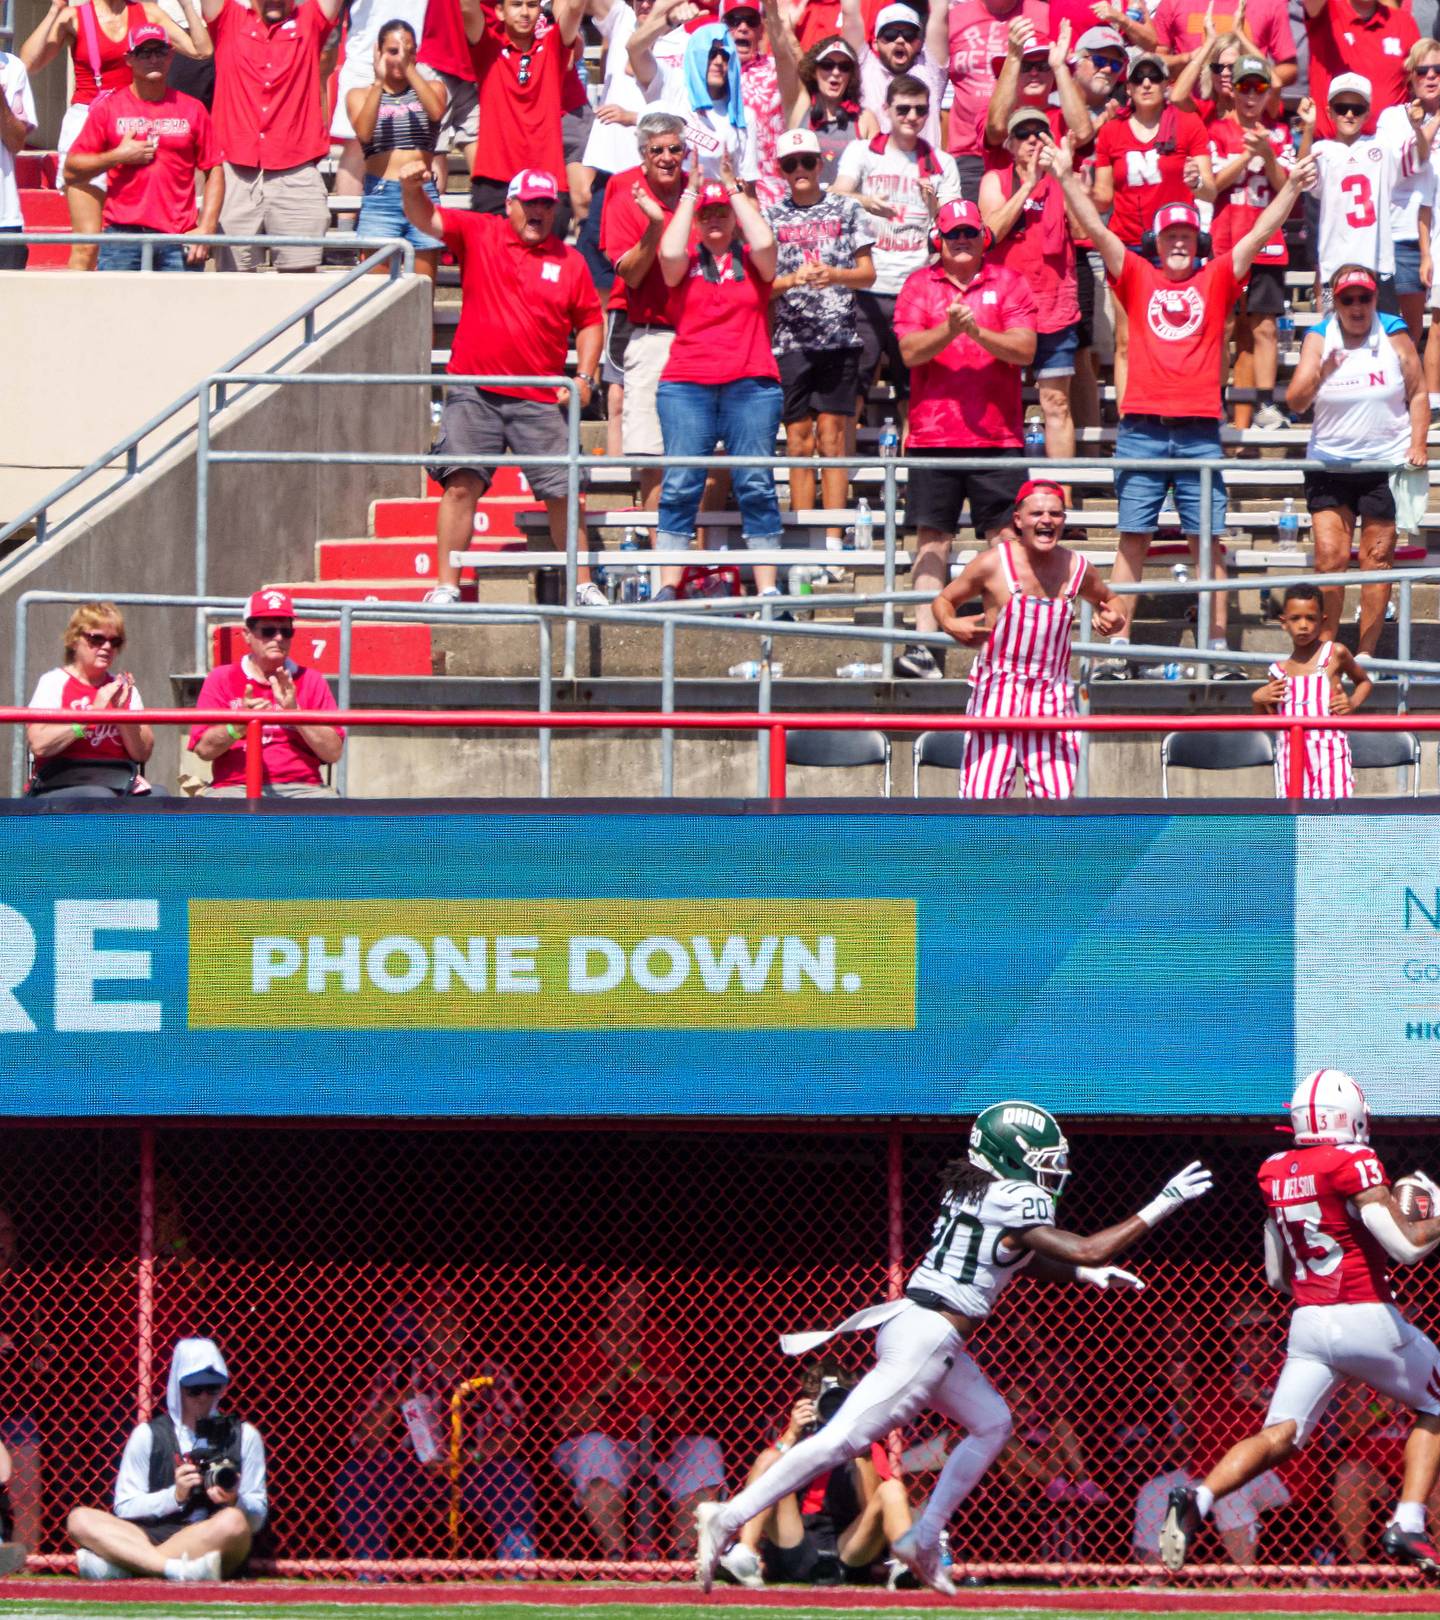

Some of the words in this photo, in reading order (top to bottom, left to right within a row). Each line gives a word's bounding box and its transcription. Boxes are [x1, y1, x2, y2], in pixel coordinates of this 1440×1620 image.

[1125, 148, 1163, 187] N
[952, 201, 968, 218] N
[1340, 173, 1377, 229] 3
[541, 261, 561, 283] N
[1368, 371, 1385, 386] N
[414, 552, 431, 575] 9
[311, 639, 328, 660] 7
[251, 935, 542, 994] PHONE
[568, 935, 862, 994] DOWN.
[1002, 1107, 1046, 1134] OHIO
[1283, 1174, 1319, 1200] NELSON
[1353, 1159, 1384, 1189] 13
[1021, 1196, 1049, 1220] 20
[1275, 1200, 1344, 1281] 13
